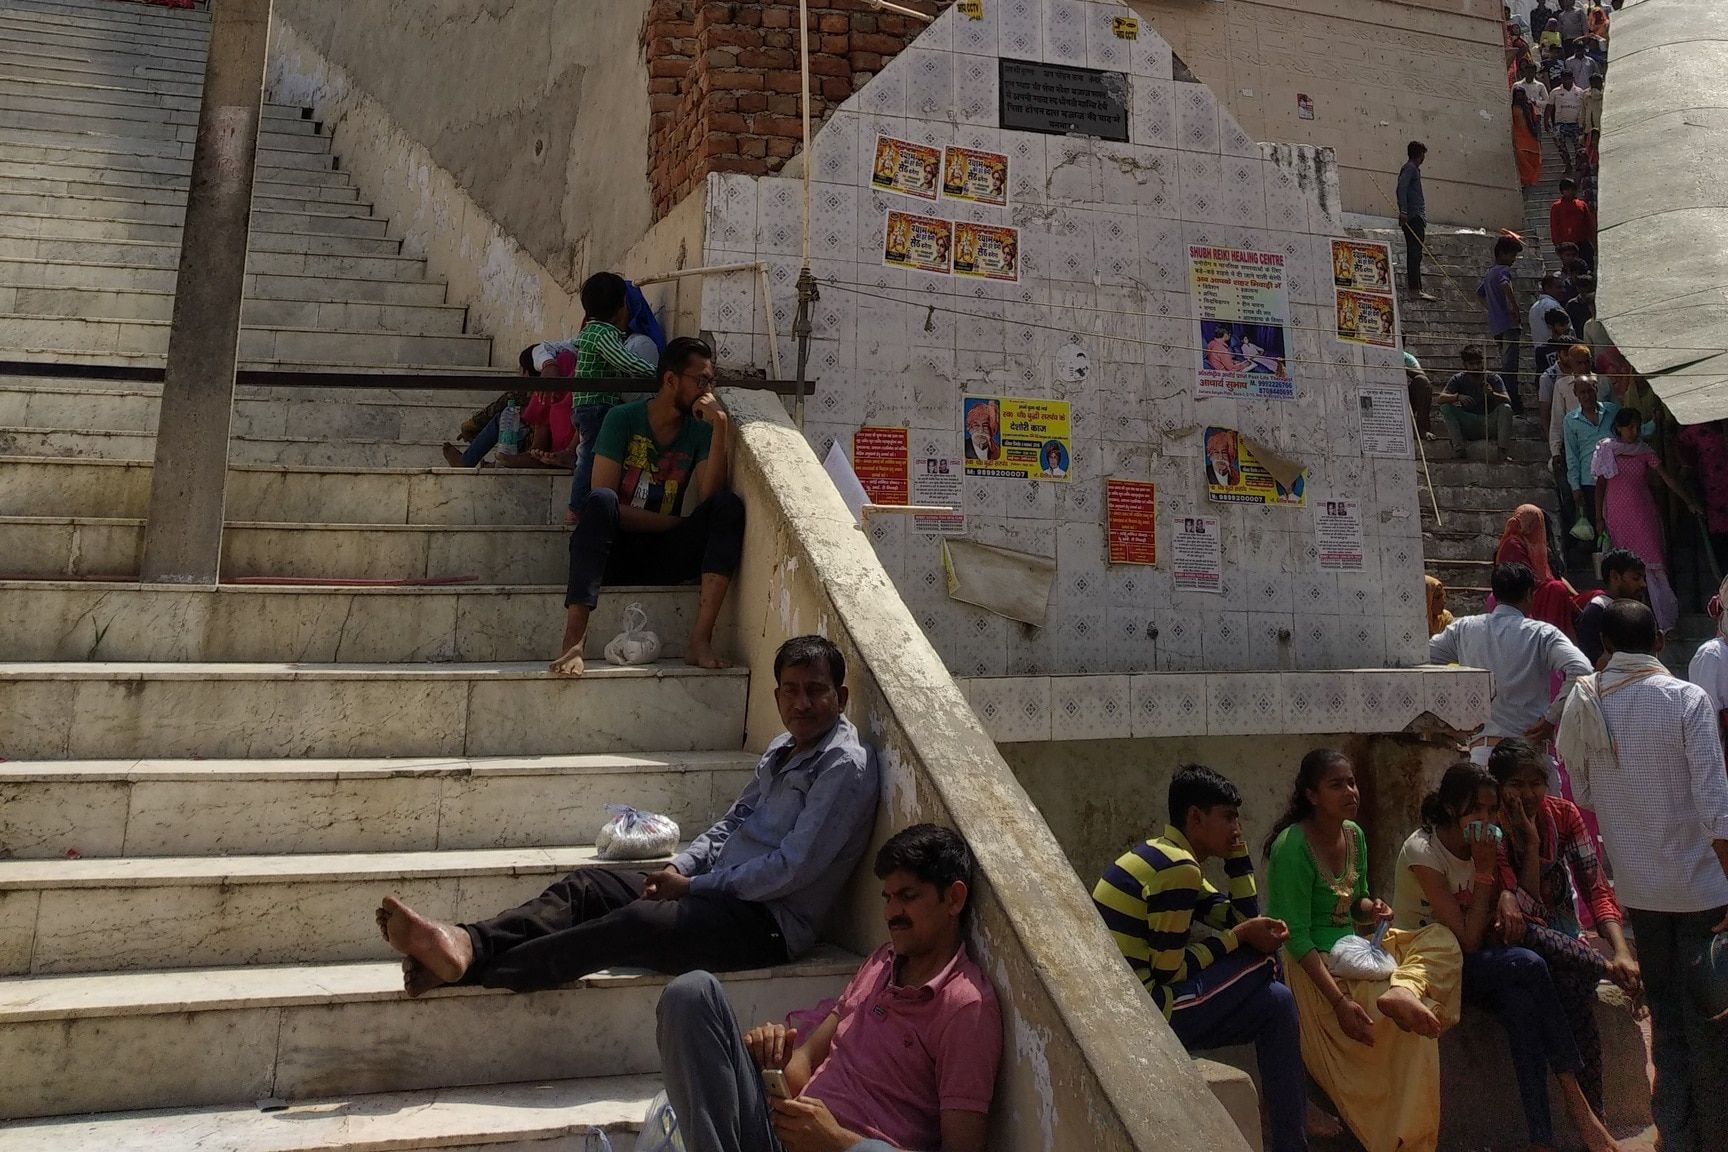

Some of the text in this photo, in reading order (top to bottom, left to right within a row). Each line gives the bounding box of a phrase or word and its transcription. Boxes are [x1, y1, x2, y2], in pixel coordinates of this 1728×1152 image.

[1189, 246, 1284, 267] SHUBH REIKI HEALING CENTRE
[1200, 378, 1224, 388] आचार्य
[1225, 380, 1248, 392] सुभाष
